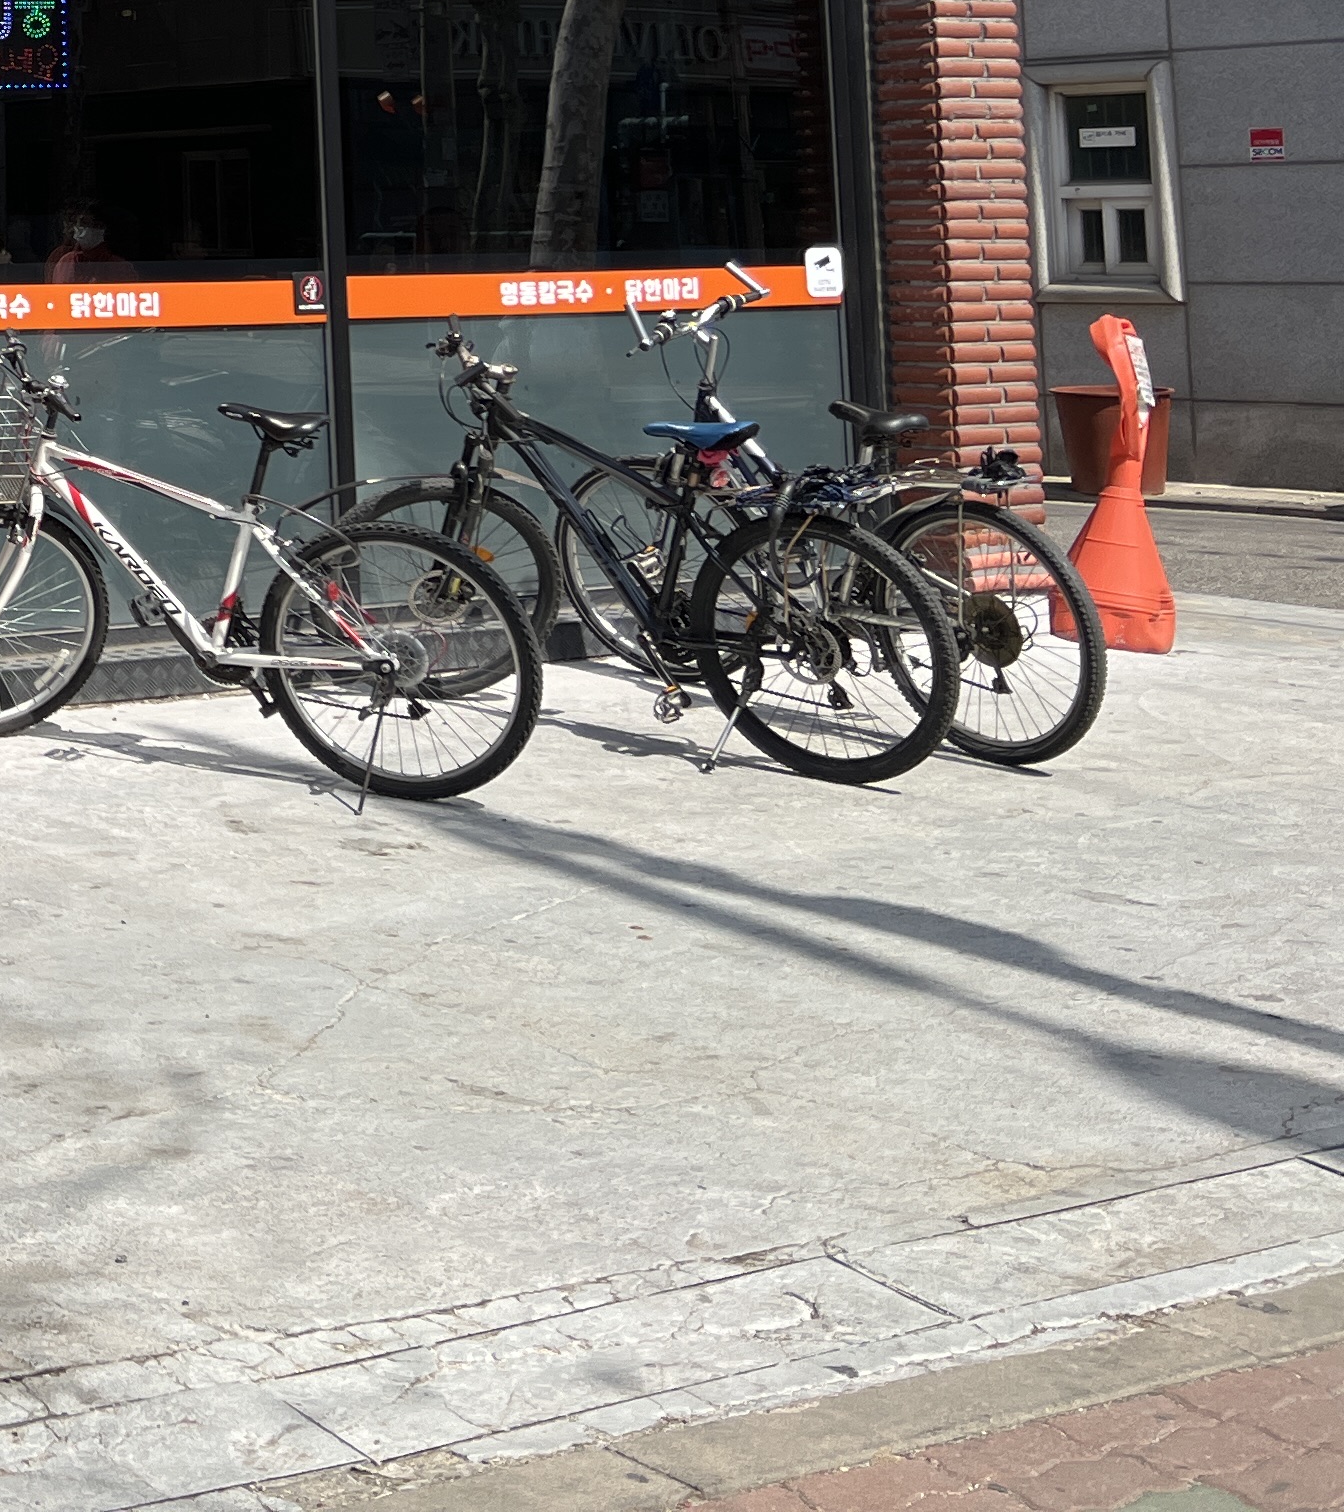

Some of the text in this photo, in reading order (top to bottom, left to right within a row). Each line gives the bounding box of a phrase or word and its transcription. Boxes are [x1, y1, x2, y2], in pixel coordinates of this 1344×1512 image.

[69, 291, 161, 318] 닭한마리
[499, 276, 700, 307] 명동칼국수 닭한마리
